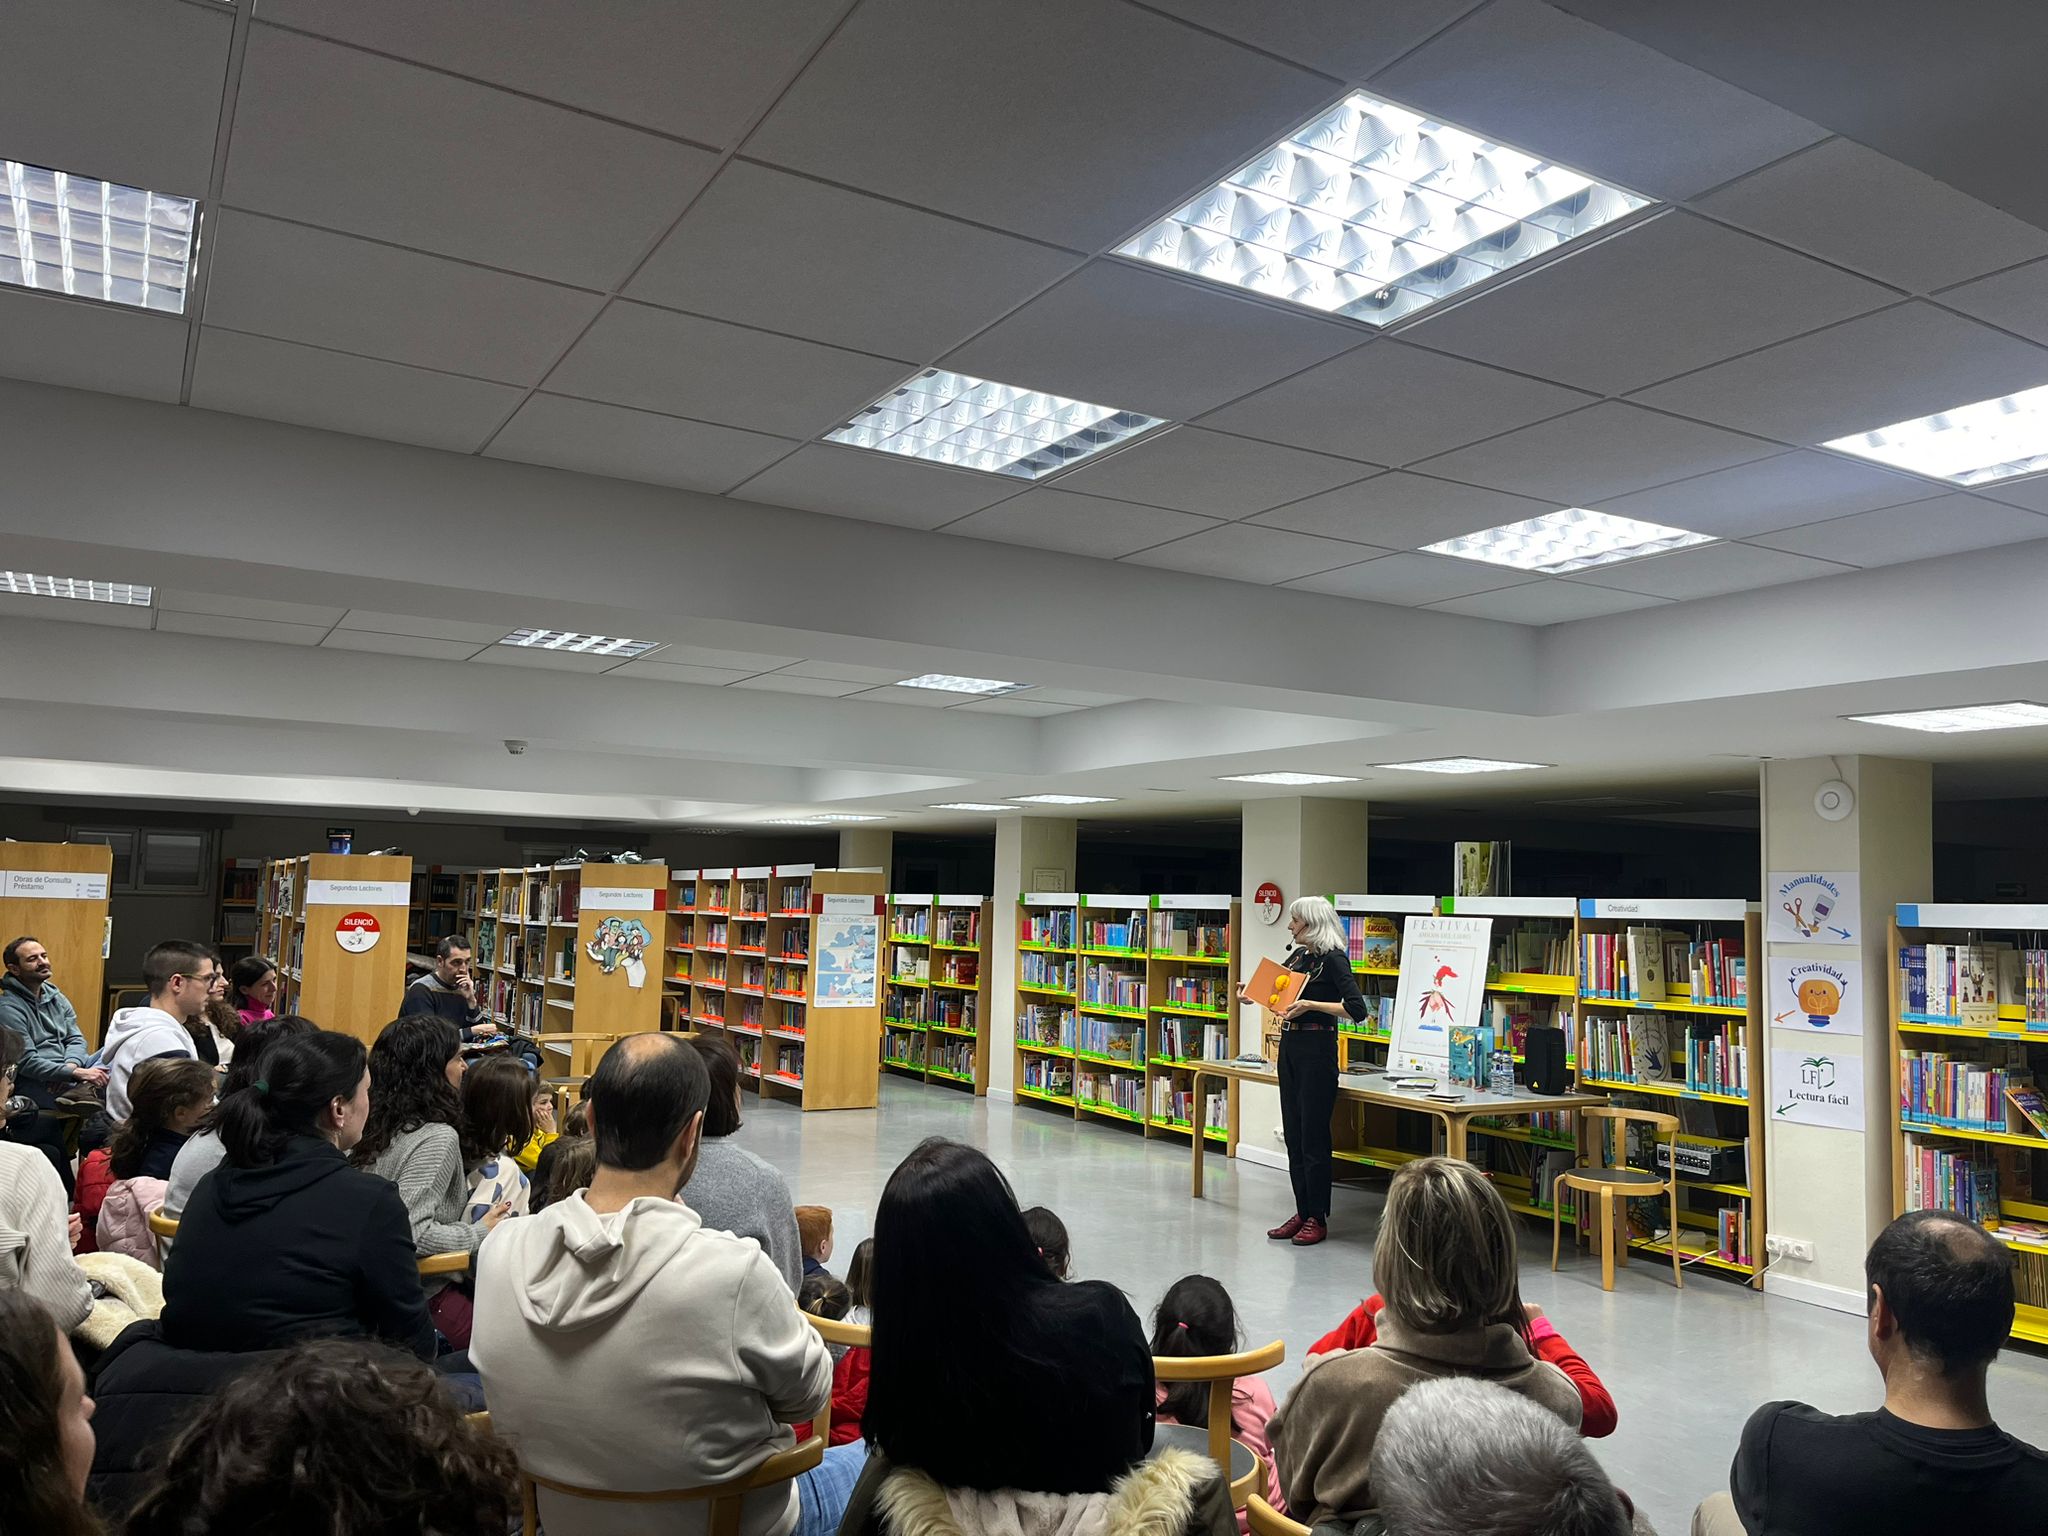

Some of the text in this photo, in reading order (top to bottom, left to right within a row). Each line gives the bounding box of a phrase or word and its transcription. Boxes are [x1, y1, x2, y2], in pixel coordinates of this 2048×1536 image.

[14, 875, 33, 883] Obras
[44, 876, 72, 884] Consulta
[1779, 873, 1841, 898] Manualidades
[1607, 904, 1639, 913] Creatividad
[344, 918, 374, 926] SILENCIO
[1413, 919, 1481, 932] FESTIVAL
[1790, 963, 1844, 981] Creatividad
[1789, 1088, 1849, 1106] Lectura fácil
